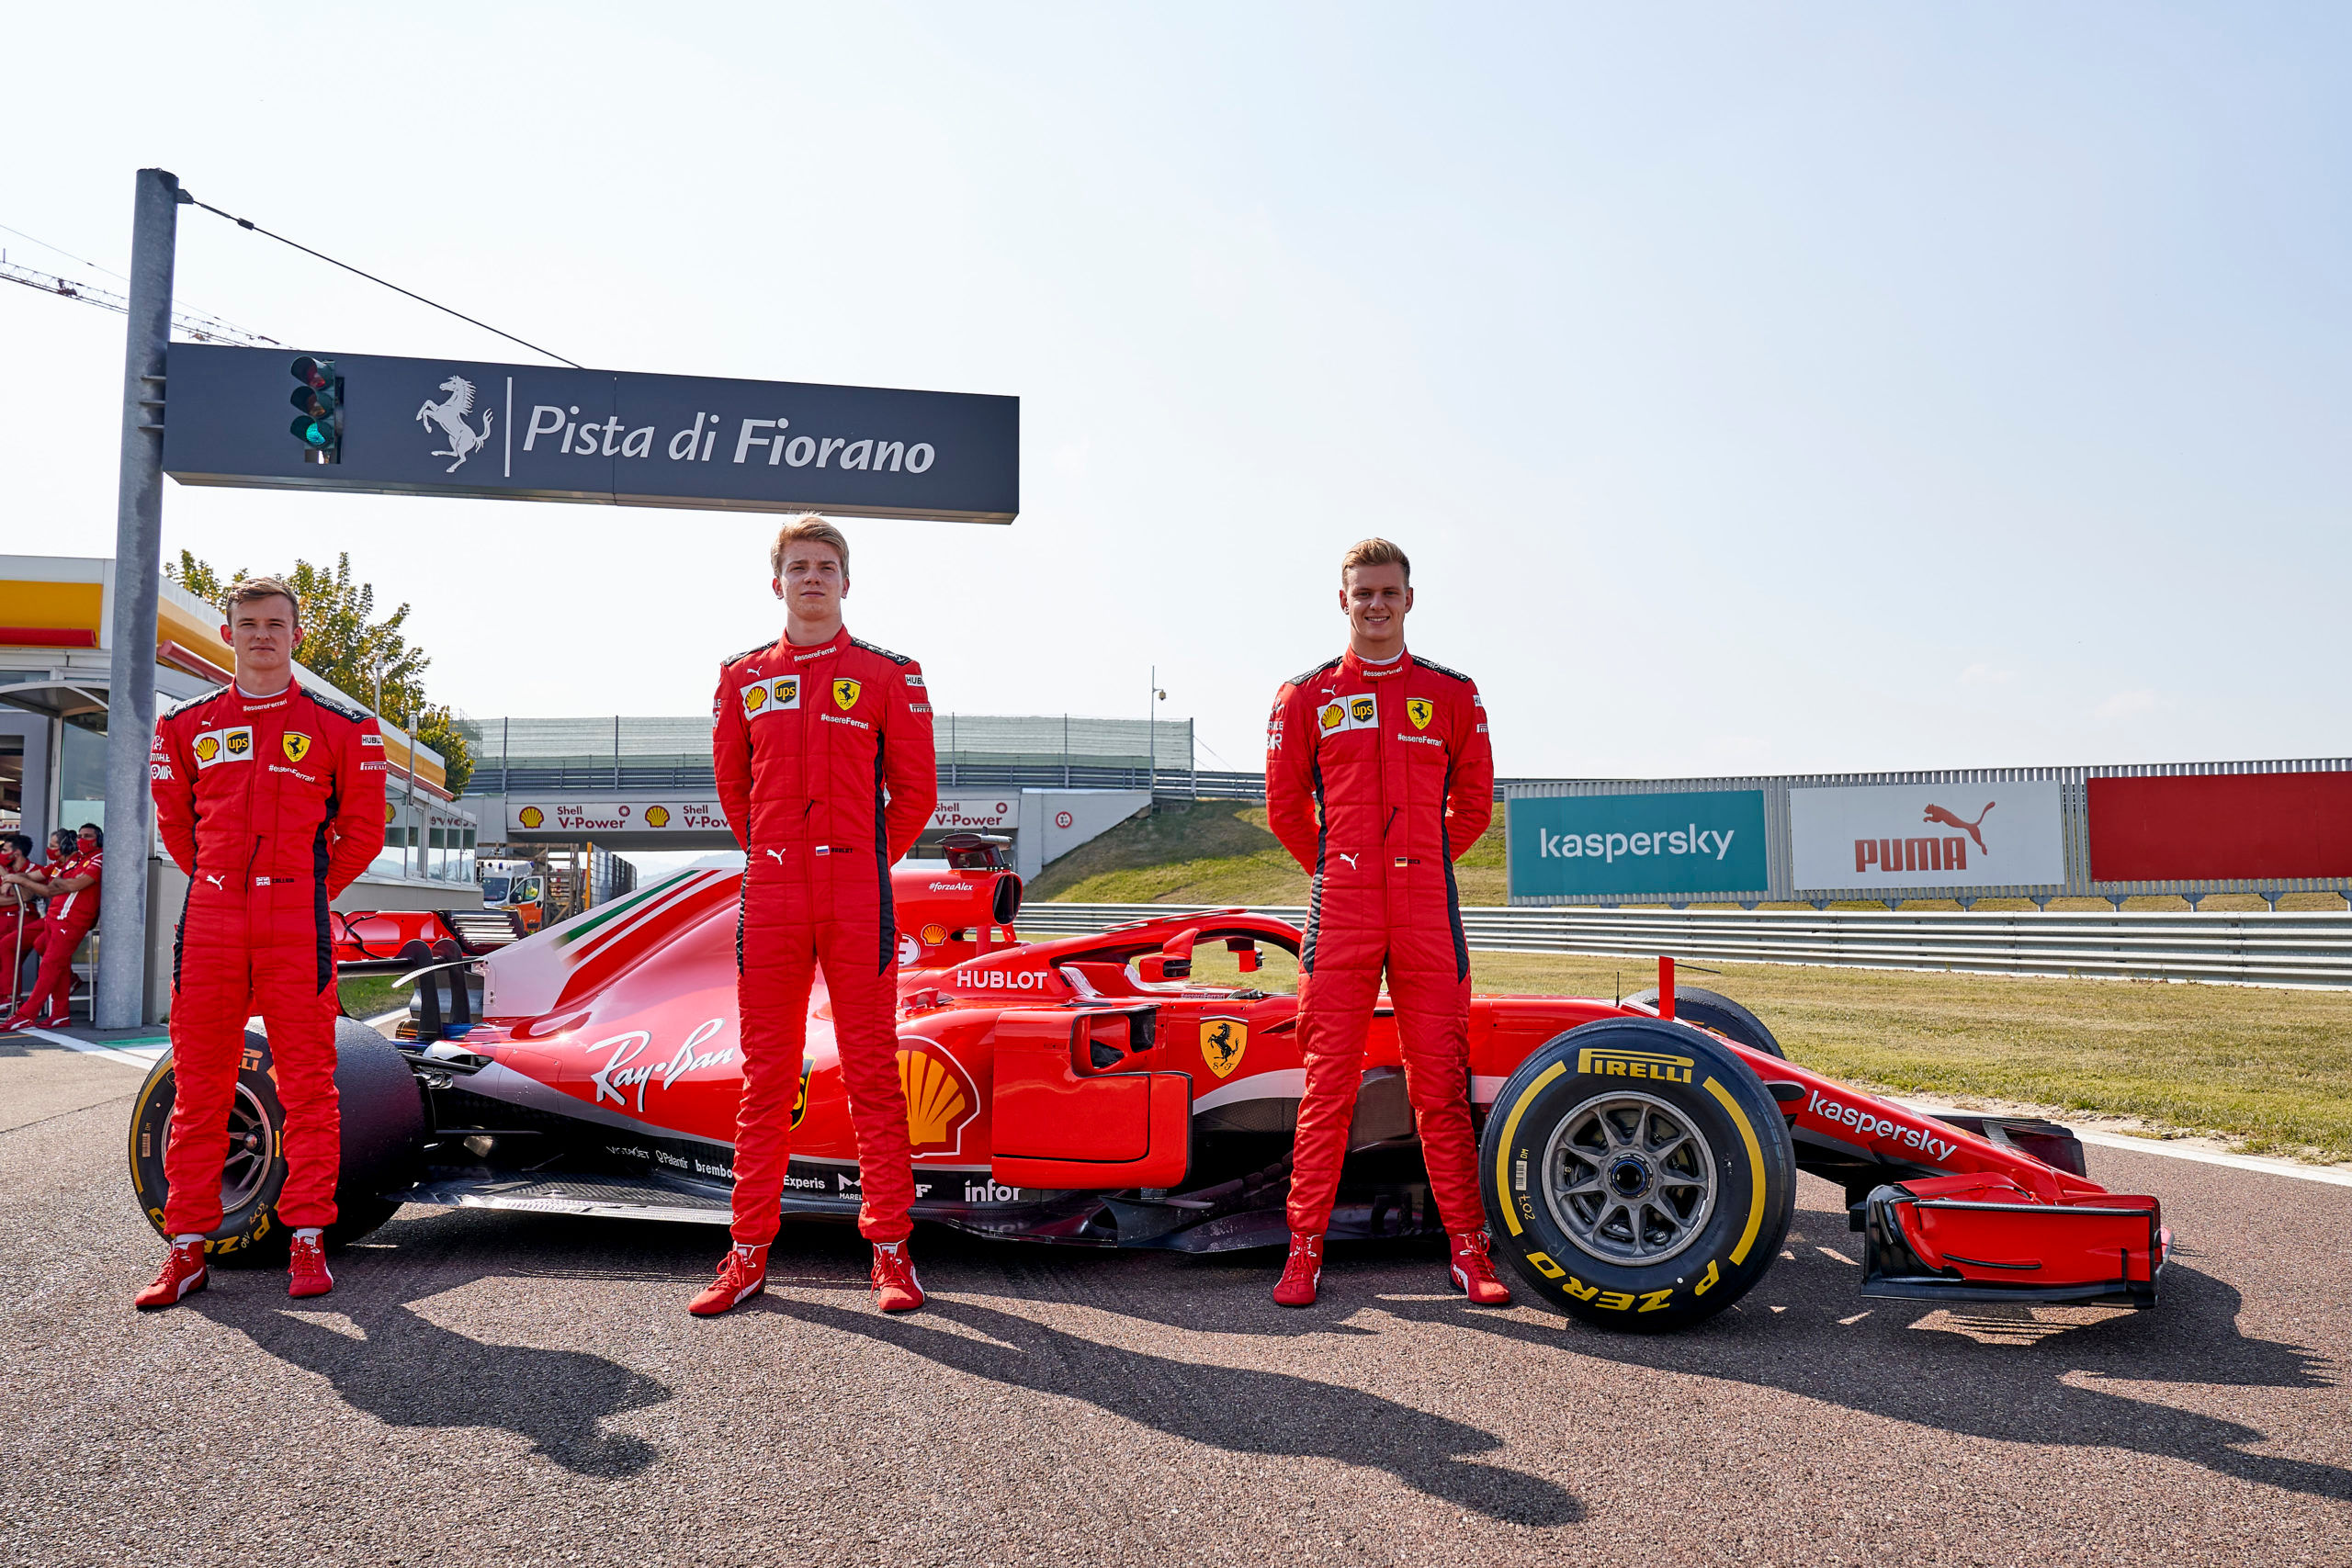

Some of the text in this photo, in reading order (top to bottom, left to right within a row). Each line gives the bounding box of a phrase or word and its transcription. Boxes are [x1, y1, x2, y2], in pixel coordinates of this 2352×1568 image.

[523, 405, 935, 474] Pista di Fiorano
[794, 645, 837, 661] #essereFerrari
[775, 686, 796, 701] ups
[243, 698, 288, 712] #essereFerrari
[313, 694, 361, 719] kaspersky
[1352, 705, 1374, 720] ups
[820, 714, 869, 730] #essereFerrari
[228, 738, 248, 752] ups
[1397, 732, 1442, 748] #essereFerrari
[557, 805, 582, 816] Shell
[683, 805, 708, 815] Shell
[934, 803, 960, 813] Shell
[559, 817, 626, 829] V-Power
[935, 813, 1003, 827] V-Power
[1540, 823, 1735, 863] kaspersky
[1854, 836, 1967, 873] PUMA
[928, 882, 974, 893] #forzaAlex
[956, 970, 1048, 990] HUBLOT
[1577, 1048, 1695, 1084] PIRELLI
[1807, 1089, 1958, 1162] kaspersky
[695, 1158, 734, 1179] brembo
[783, 1175, 826, 1190] Experis
[965, 1179, 1021, 1202] infor
[1526, 1250, 1721, 1314] P ZERO
